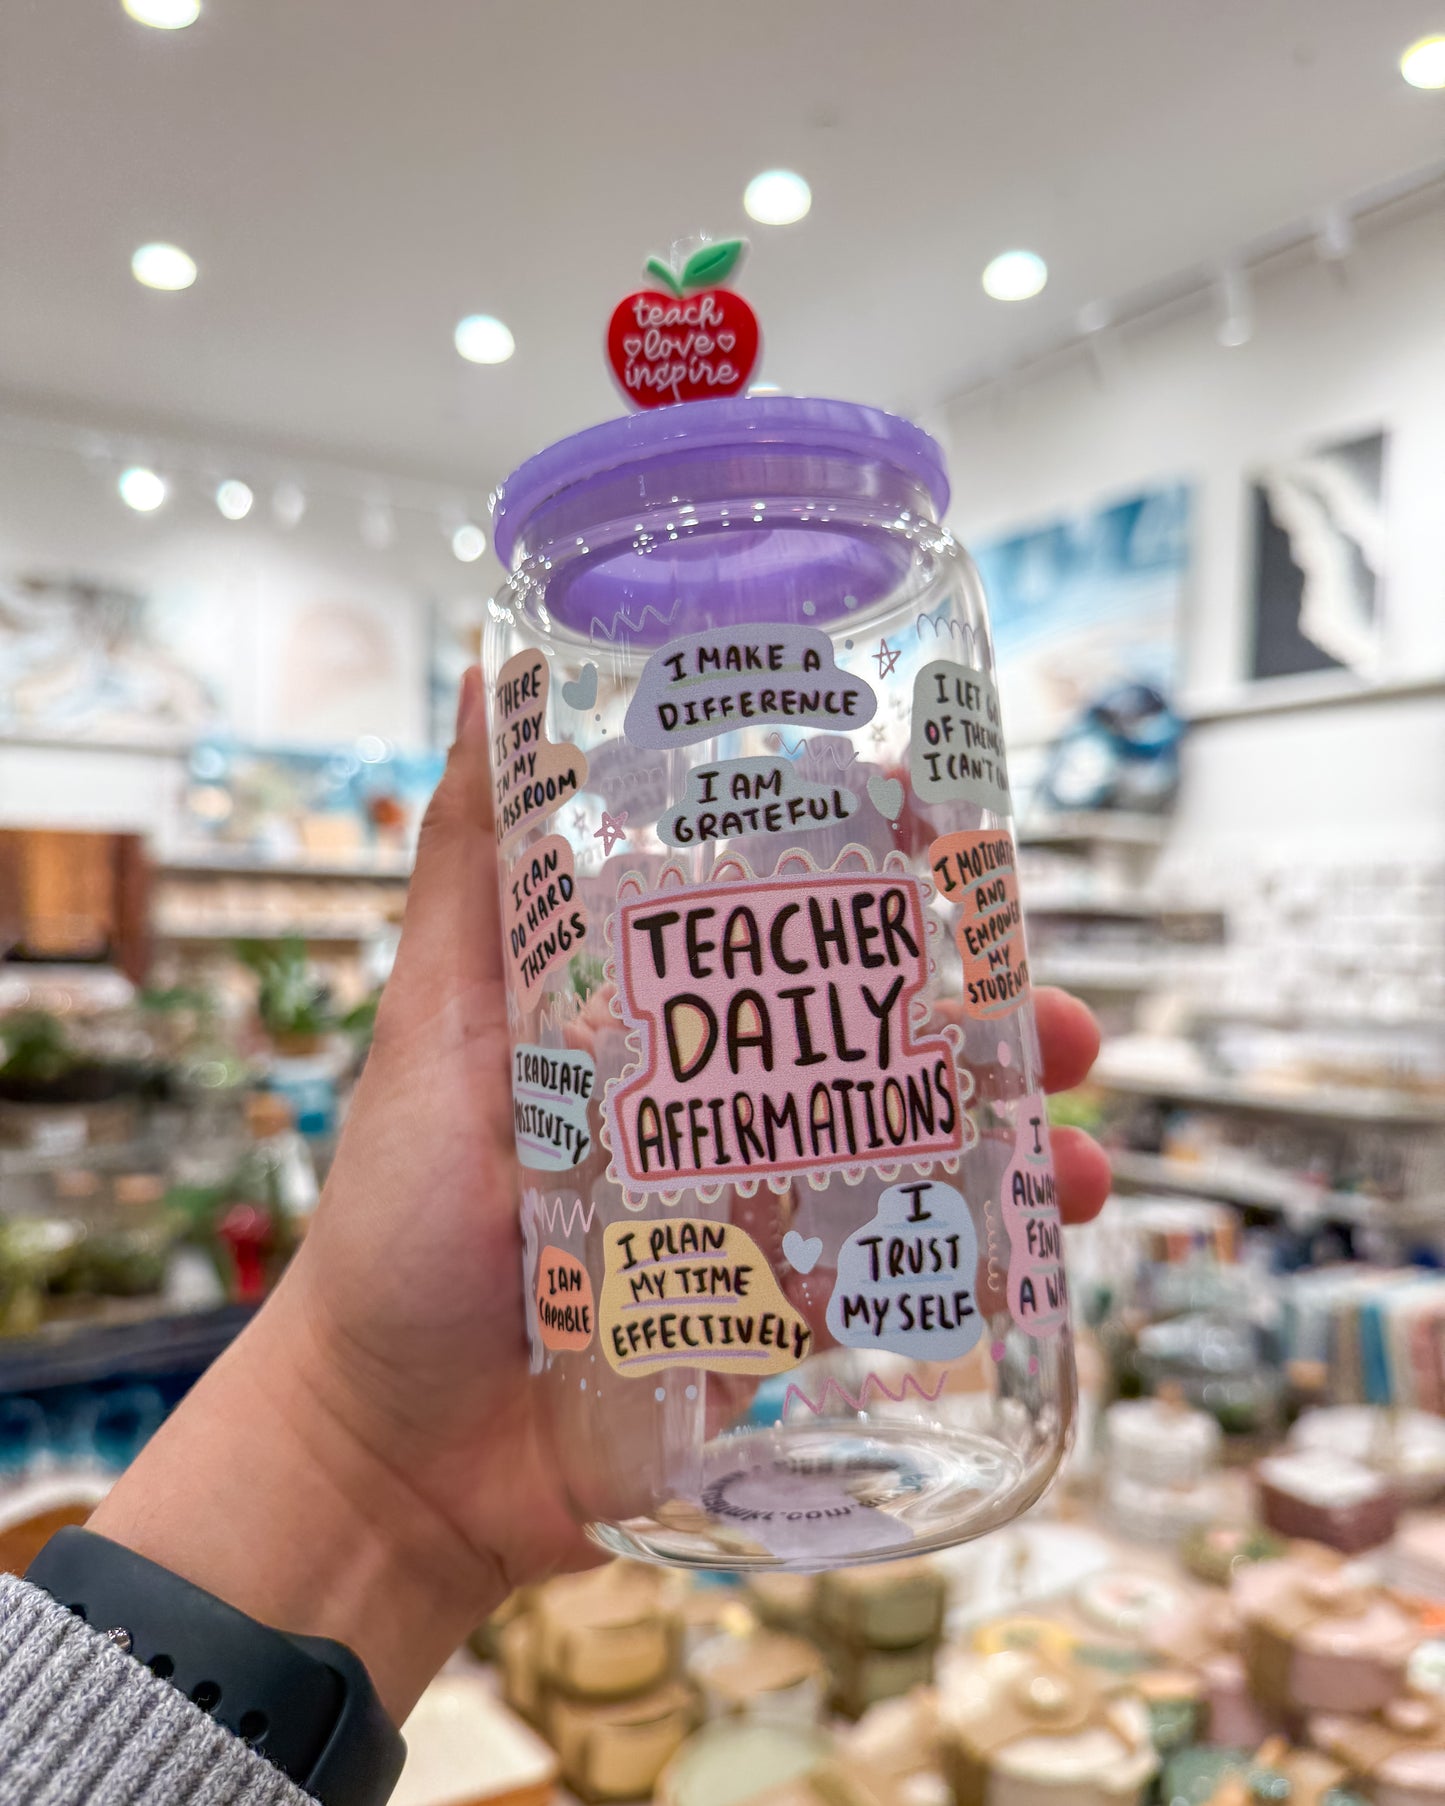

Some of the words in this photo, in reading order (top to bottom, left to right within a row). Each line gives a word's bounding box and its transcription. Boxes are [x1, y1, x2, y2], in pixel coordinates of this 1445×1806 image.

[633, 297, 723, 329] teach
[644, 329, 715, 361] love
[625, 356, 739, 401] inspire
[664, 652, 687, 681] I
[697, 645, 785, 673] MAKE
[803, 649, 821, 672] A
[497, 664, 542, 719] THERE
[658, 689, 859, 731] DIFFERENCE
[934, 674, 949, 703] I
[955, 677, 980, 710] LET
[496, 733, 508, 767] IS
[511, 711, 543, 750] JOY
[925, 715, 953, 746] OF
[513, 752, 537, 783] MY
[697, 770, 720, 804] I
[732, 768, 781, 800] AM
[923, 753, 941, 781] I
[947, 752, 992, 784] CAN'T
[674, 789, 849, 843] GRATEFUL
[512, 880, 522, 911] I
[523, 849, 557, 896] CAN
[934, 856, 956, 892] I
[511, 922, 527, 958] DO
[527, 873, 573, 931] HARD
[975, 878, 1006, 913] AND
[521, 912, 586, 988] THINGS
[633, 889, 919, 979] TEACHER
[987, 944, 1009, 971] MY
[664, 975, 905, 1083] DAILY
[516, 1051, 523, 1082] I
[524, 1053, 593, 1098] RADIATE
[637, 1060, 956, 1173] AFFIRMATIONS
[1029, 1117, 1041, 1153] I
[899, 1182, 933, 1223] I
[617, 1232, 637, 1270] I
[650, 1222, 725, 1262] PLAN
[856, 1233, 960, 1282] TRUST
[1026, 1218, 1061, 1260] FIND
[548, 1268, 556, 1295] I
[559, 1266, 582, 1292] AM
[630, 1269, 666, 1303] MY
[674, 1264, 753, 1296] TIME
[1019, 1276, 1036, 1315] A
[539, 1297, 591, 1334] CAPABLE
[841, 1290, 975, 1337] MYSELF
[611, 1312, 811, 1359] EFFECTIVELY
